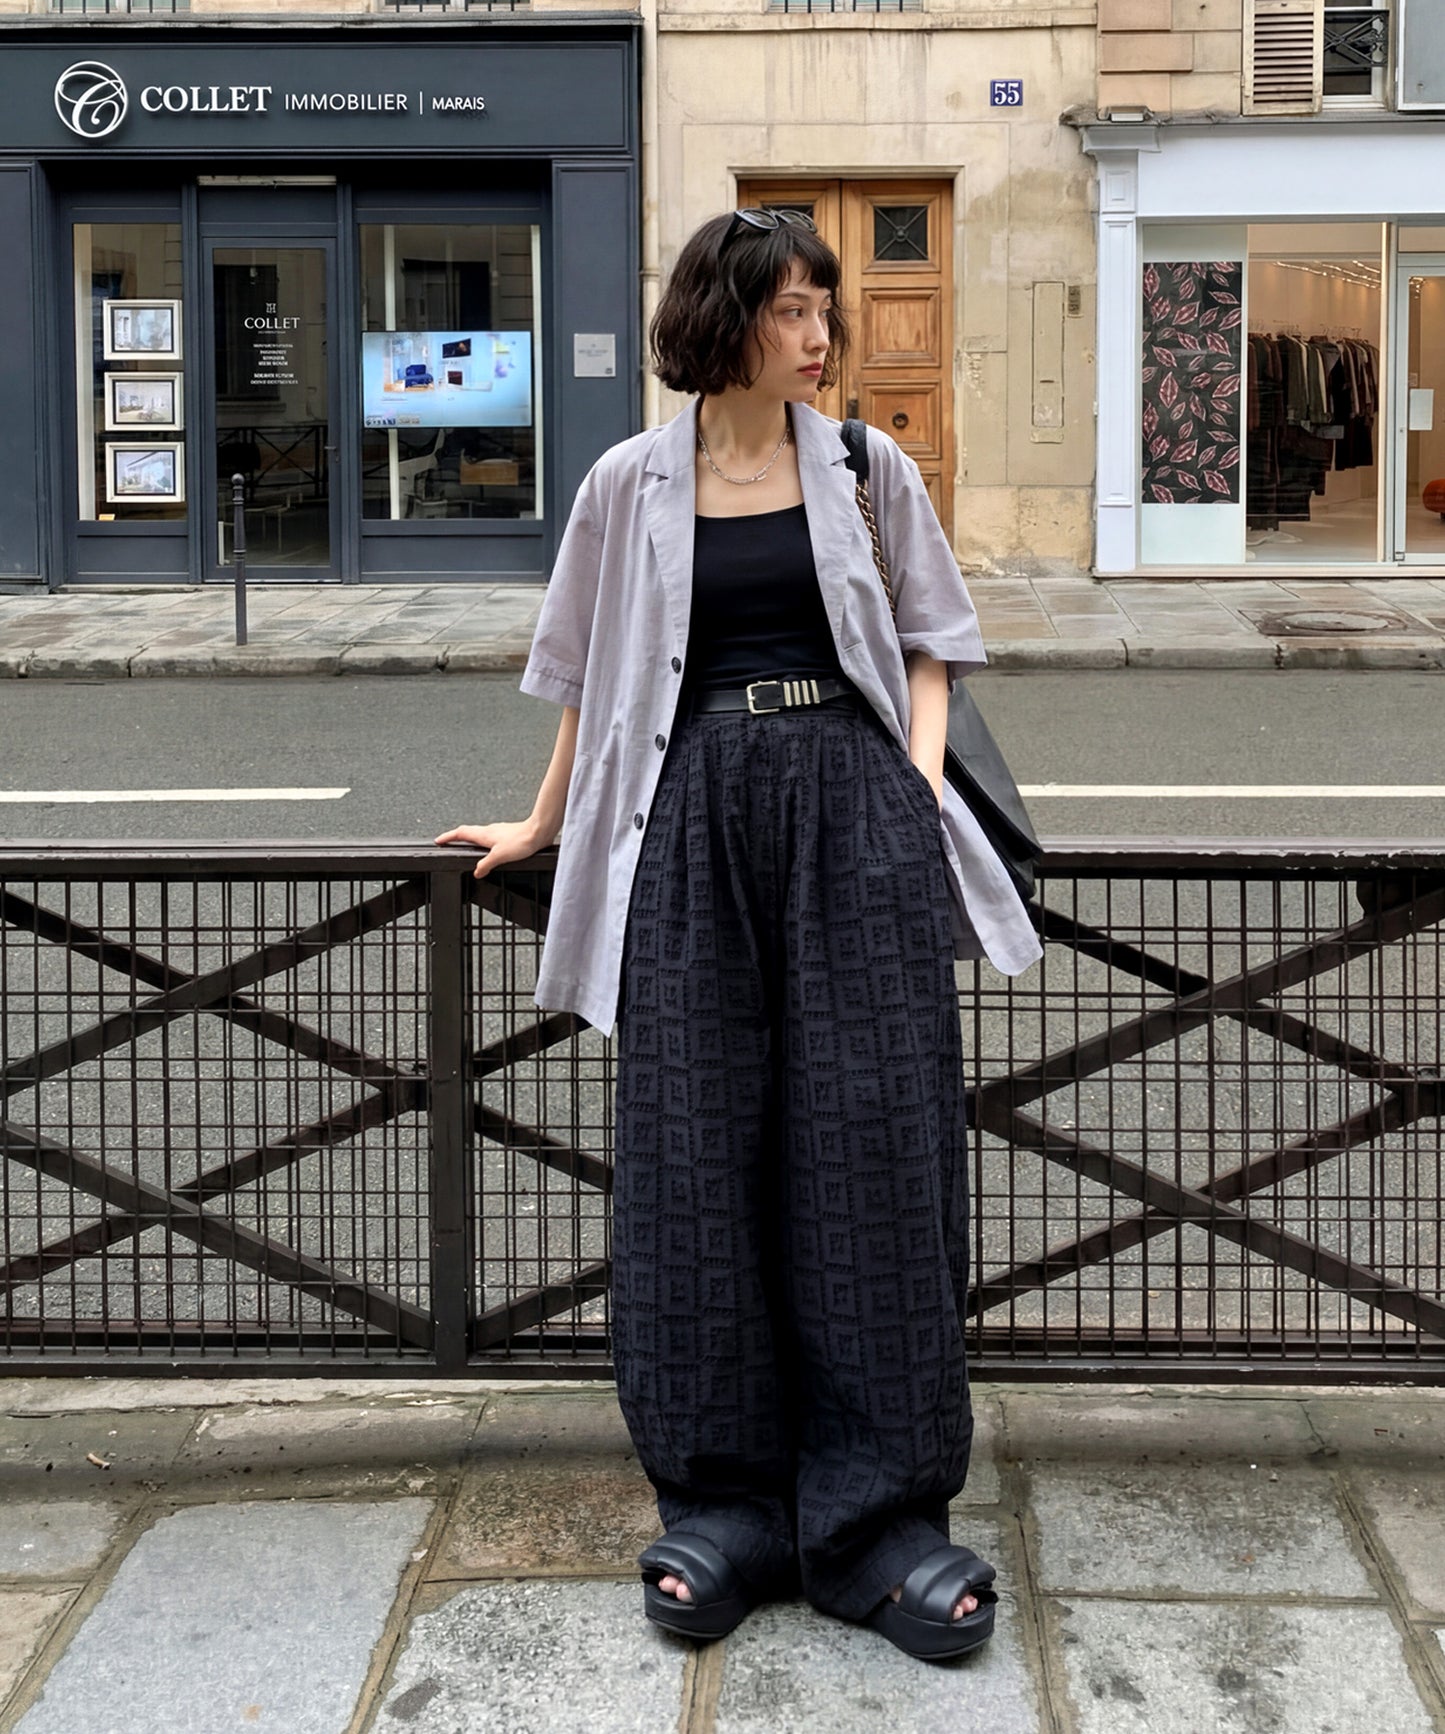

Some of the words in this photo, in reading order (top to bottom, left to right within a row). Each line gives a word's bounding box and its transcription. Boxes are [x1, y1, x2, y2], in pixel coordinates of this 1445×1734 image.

[140, 86, 272, 112] COLLET
[285, 94, 408, 110] IMMOBILIER
[432, 97, 485, 110] MARAIS
[994, 82, 1020, 105] 55
[244, 317, 300, 329] COLLET
